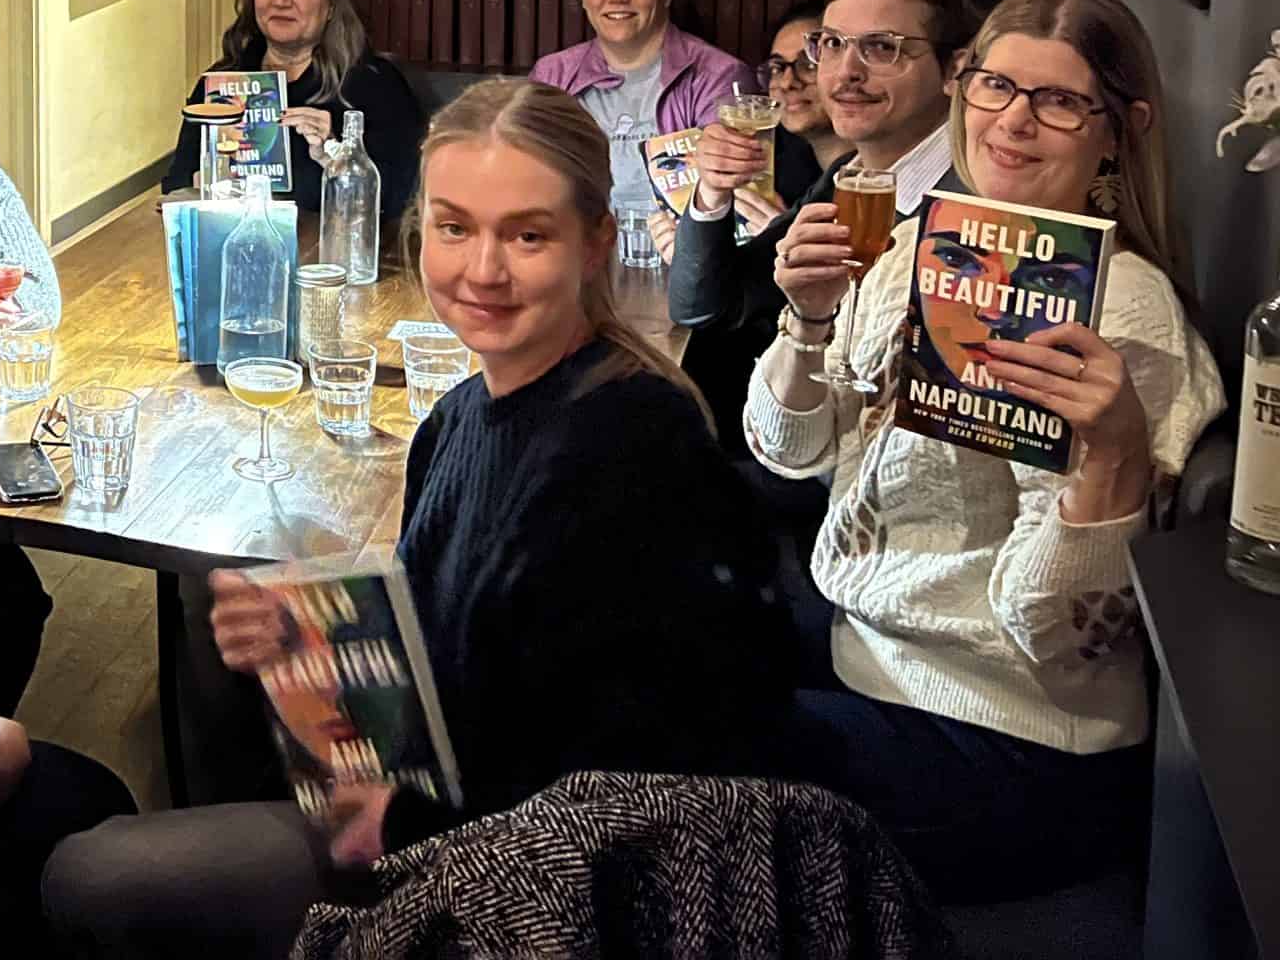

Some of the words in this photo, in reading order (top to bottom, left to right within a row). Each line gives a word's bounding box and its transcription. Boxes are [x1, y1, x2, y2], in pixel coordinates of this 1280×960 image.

[219, 80, 261, 96] HELLO
[236, 149, 260, 161] ANN
[959, 218, 1056, 263] HELLO
[919, 266, 1078, 325] BEAUTIFUL
[909, 379, 1064, 440] NAPOLITANO
[949, 417, 970, 429] TIMES
[947, 424, 973, 439] DEAR
[975, 432, 1016, 451] EDWARD
